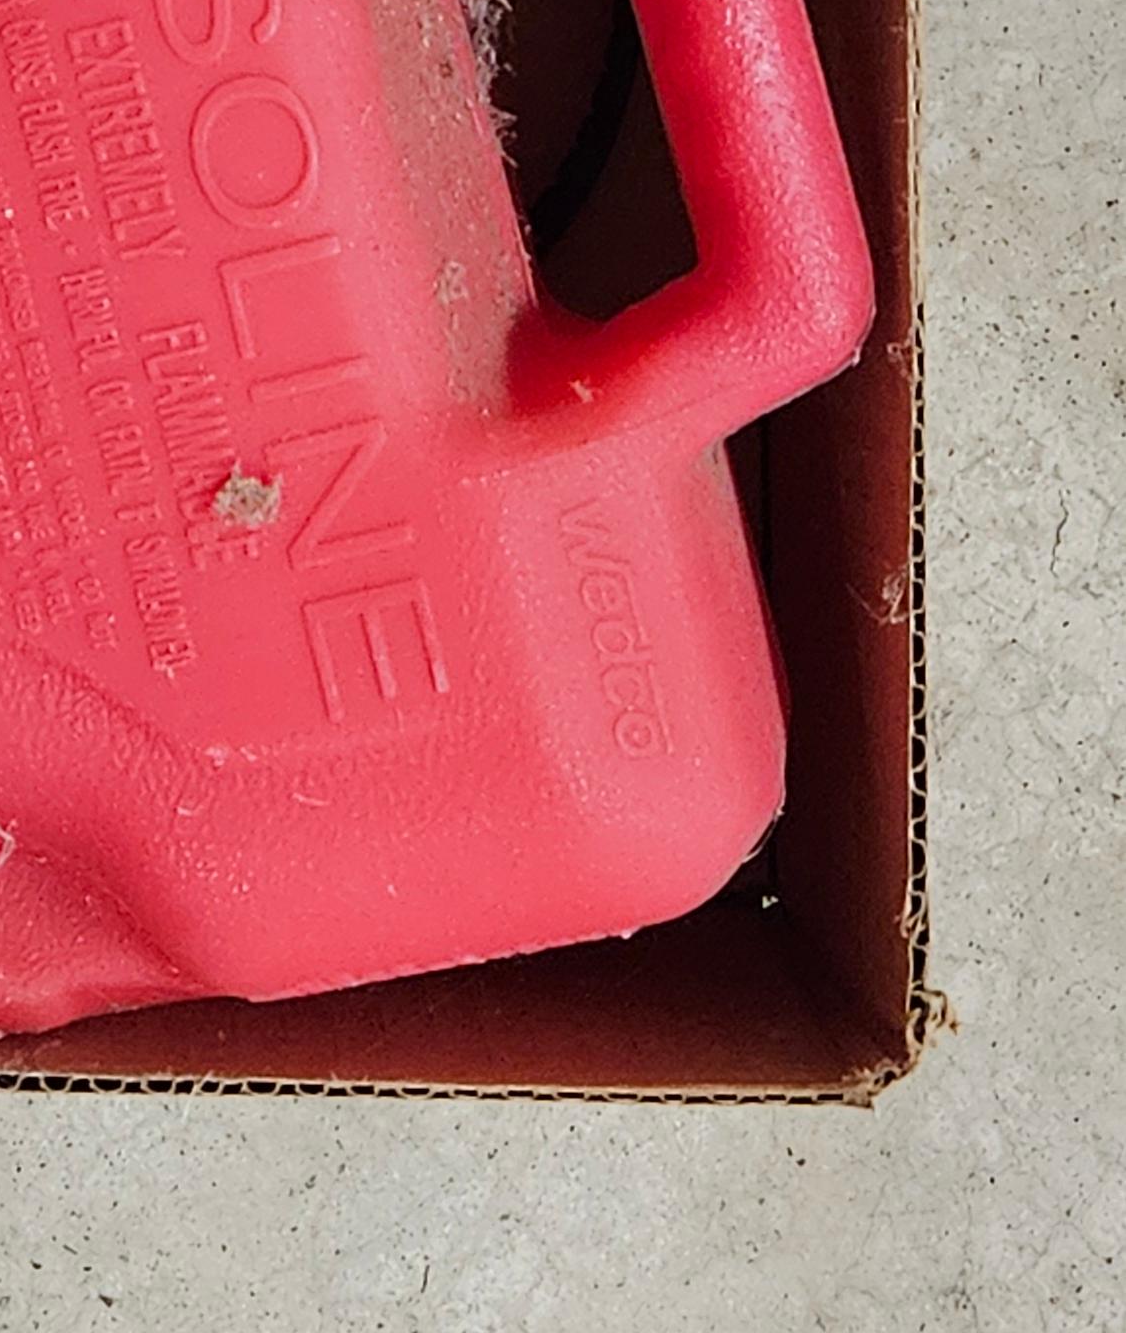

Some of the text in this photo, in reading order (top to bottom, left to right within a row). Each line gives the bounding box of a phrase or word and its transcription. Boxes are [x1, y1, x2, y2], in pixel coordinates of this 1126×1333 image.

[0, 15, 59, 93] CAUSE
[18, 96, 77, 170] FLASH
[60, 16, 187, 269] EXTREMELY
[36, 172, 91, 231] FIRE
[58, 265, 125, 373] HARMFUL
[85, 376, 135, 418] OR
[95, 422, 154, 496] FATAL
[557, 499, 678, 764] wedco
